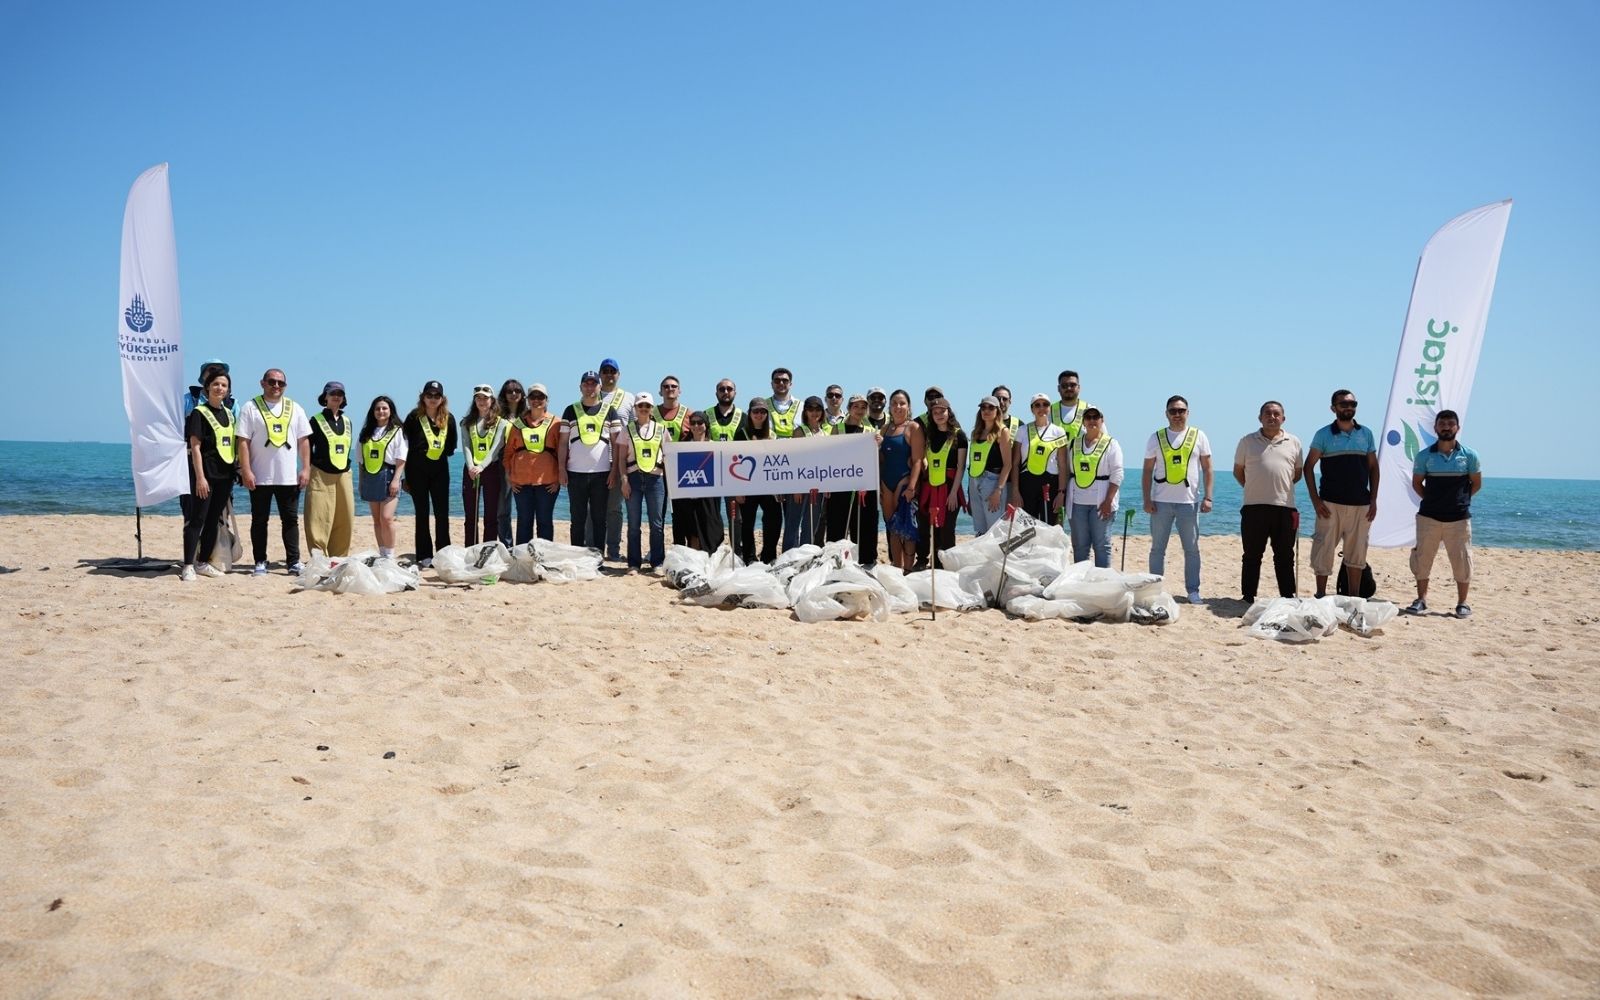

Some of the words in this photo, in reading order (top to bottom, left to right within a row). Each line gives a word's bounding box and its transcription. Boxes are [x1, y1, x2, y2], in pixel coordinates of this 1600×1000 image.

[119, 334, 166, 344] STANBUL
[118, 342, 178, 354] YÜKŞEHİR
[1406, 318, 1459, 406] istaç
[763, 454, 790, 467] AXA
[678, 470, 708, 485] AXA
[763, 468, 793, 481] Tüm
[797, 464, 864, 481] Kalplerde
